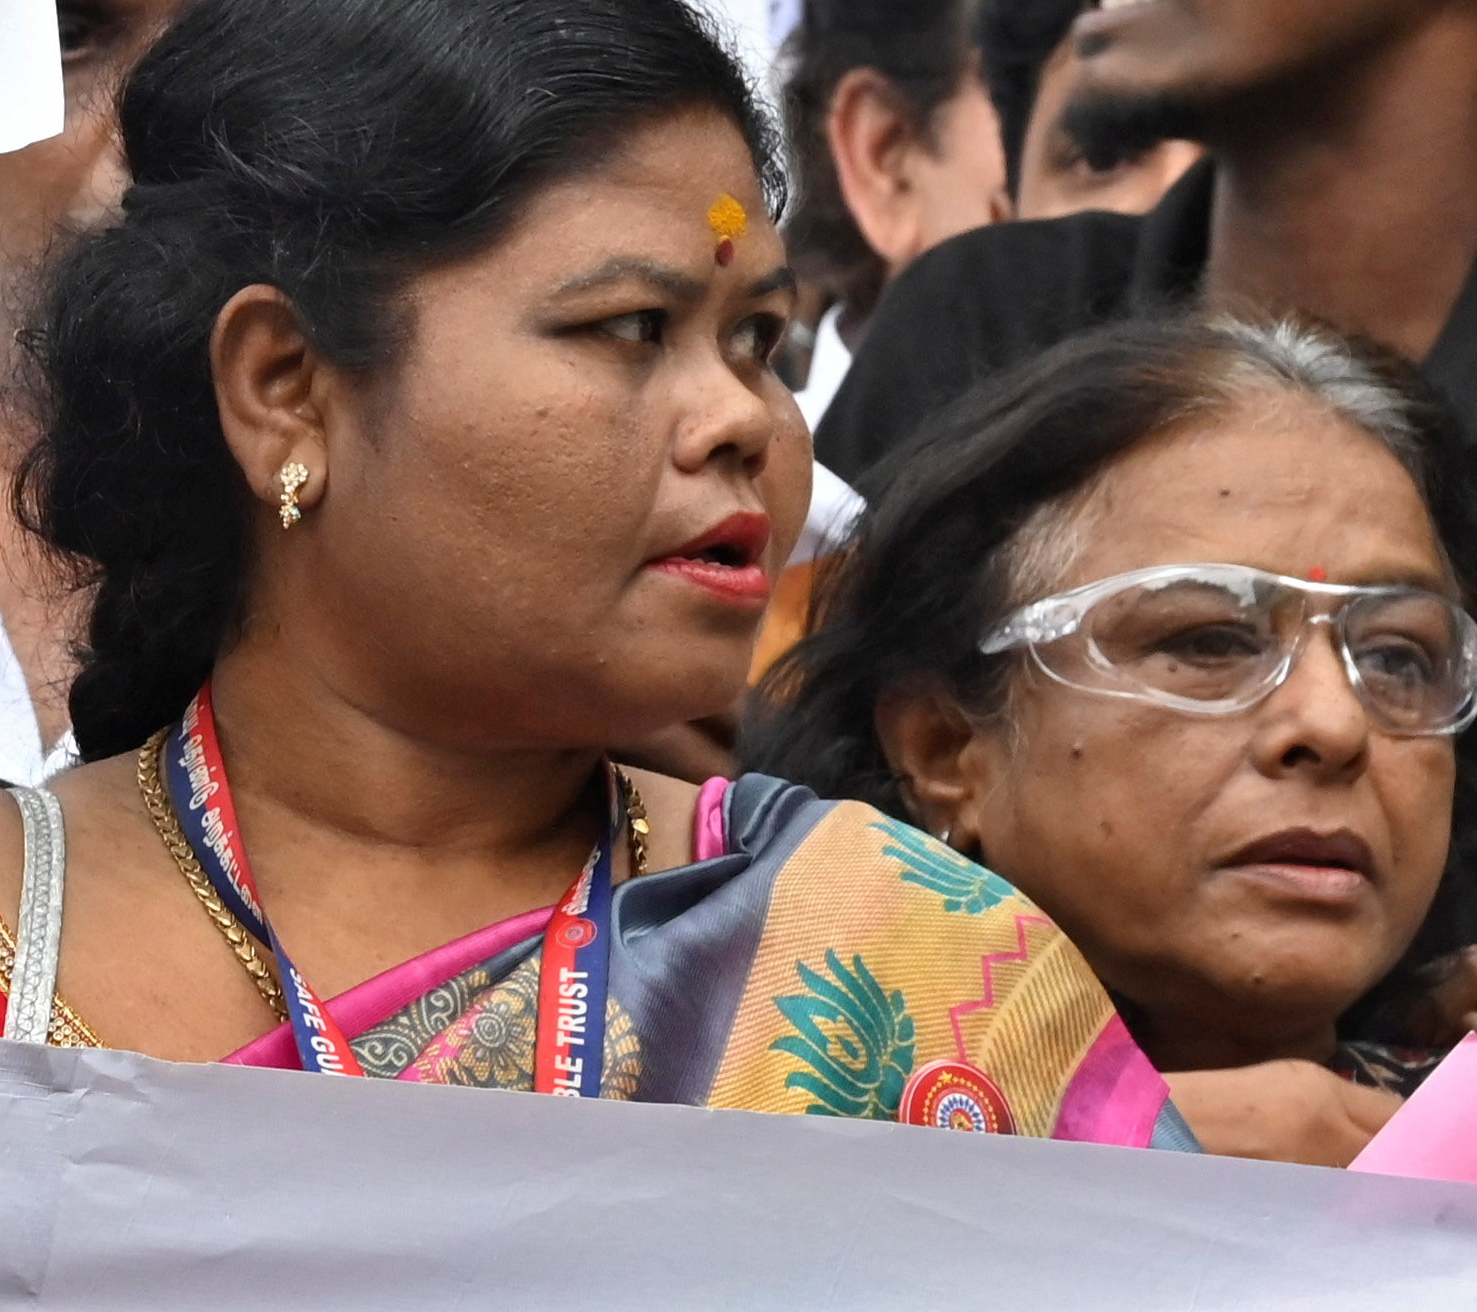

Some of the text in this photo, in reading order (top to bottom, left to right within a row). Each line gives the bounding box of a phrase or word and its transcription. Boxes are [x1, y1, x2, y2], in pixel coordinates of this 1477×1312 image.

[289, 967, 348, 1077] SAFE GU
[555, 966, 590, 1047] TRUST
